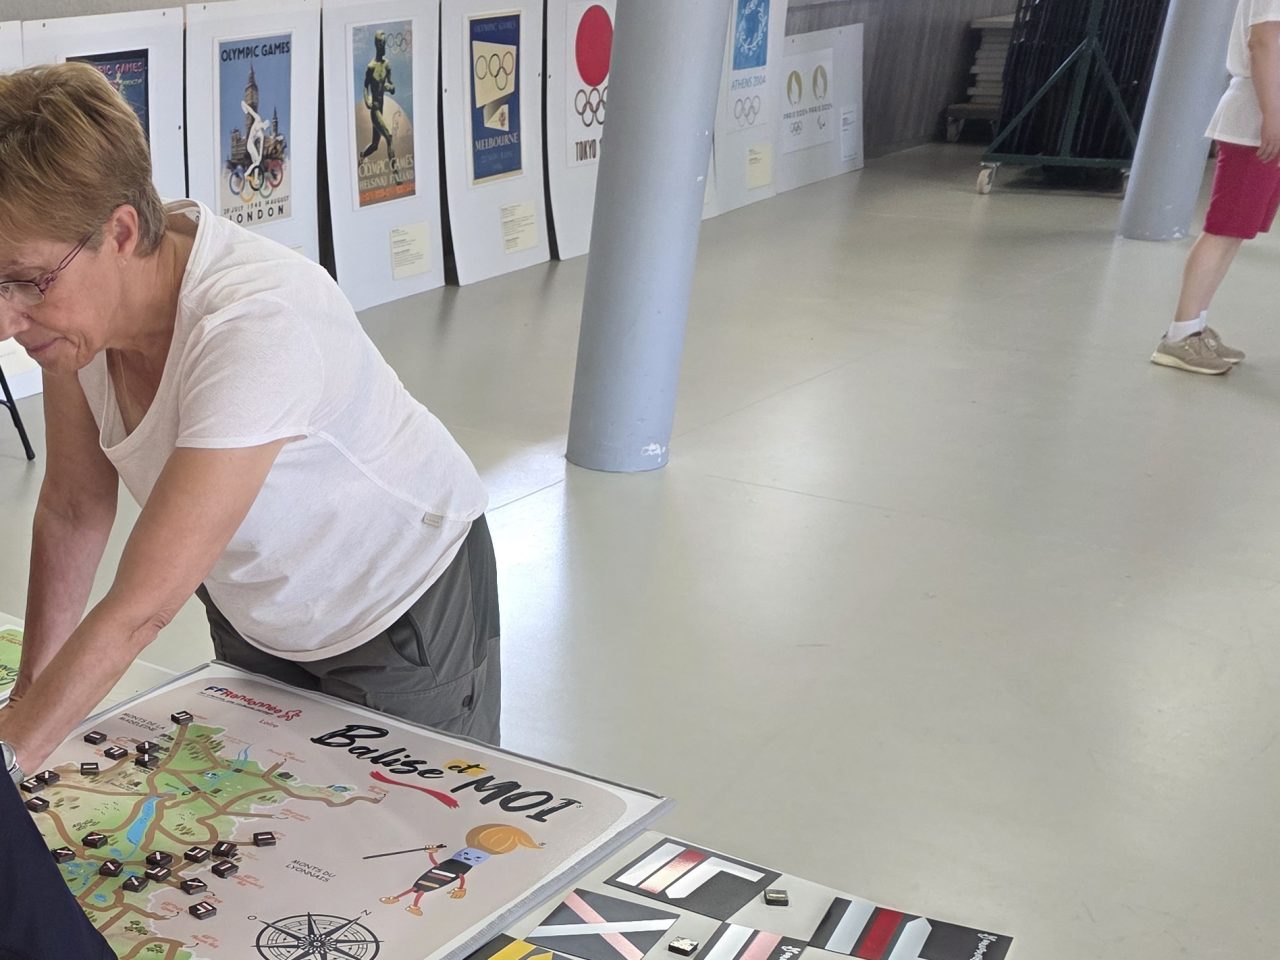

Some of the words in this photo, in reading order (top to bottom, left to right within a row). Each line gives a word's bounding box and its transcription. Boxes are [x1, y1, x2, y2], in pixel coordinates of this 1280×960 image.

[221, 45, 260, 63] OLYMPIC
[261, 41, 290, 55] GAMES
[731, 77, 752, 91] ATHENS
[753, 75, 766, 88] 2004
[475, 132, 519, 152] MELBOURNE
[575, 139, 597, 161] TOKYO
[359, 159, 390, 178] OLYMPIC
[122, 712, 148, 724] MONTS
[310, 724, 445, 780] Balise
[447, 762, 482, 775] et
[450, 774, 579, 823] MOI
[285, 864, 331, 883] LYONNAIS
[291, 859, 322, 874] MONTS
[323, 870, 337, 878] DU
